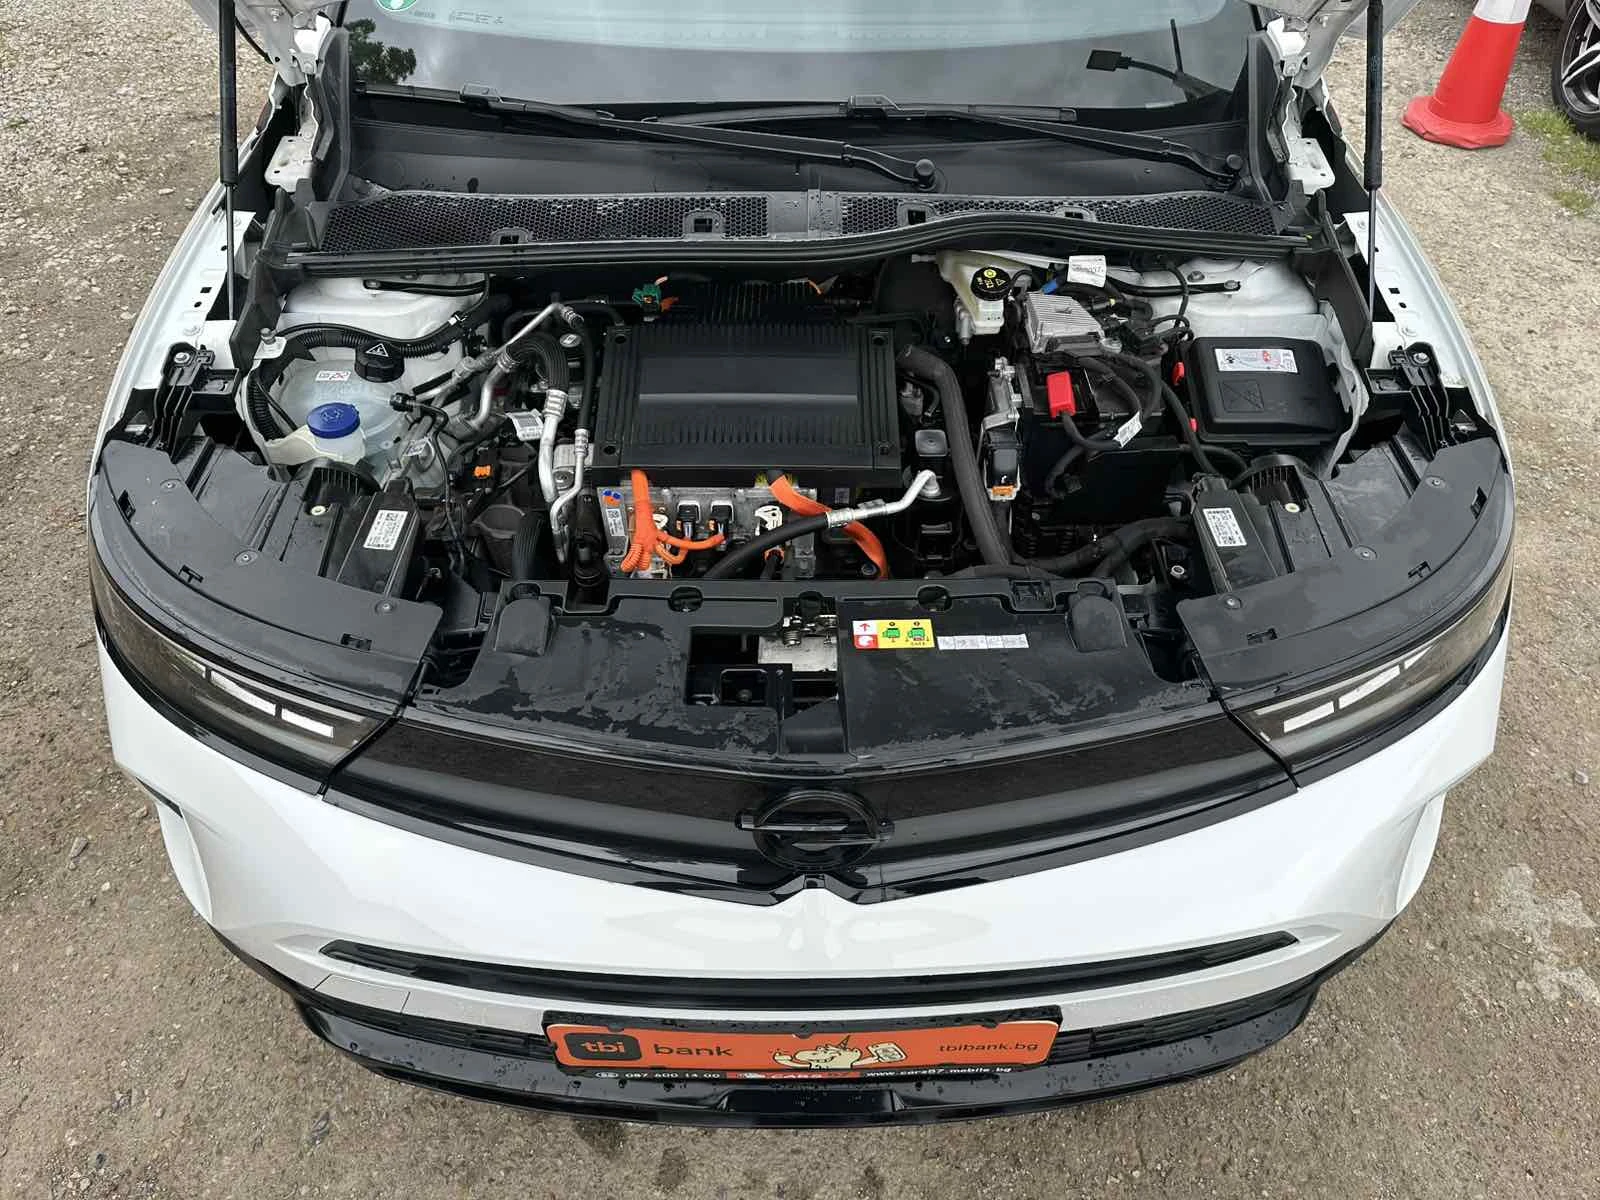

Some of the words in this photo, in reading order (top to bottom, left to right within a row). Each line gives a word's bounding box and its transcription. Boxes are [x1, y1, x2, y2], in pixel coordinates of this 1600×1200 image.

[580, 1041, 625, 1054] tbi
[654, 1044, 733, 1057] bank
[939, 1042, 1039, 1053] tbibank.bg
